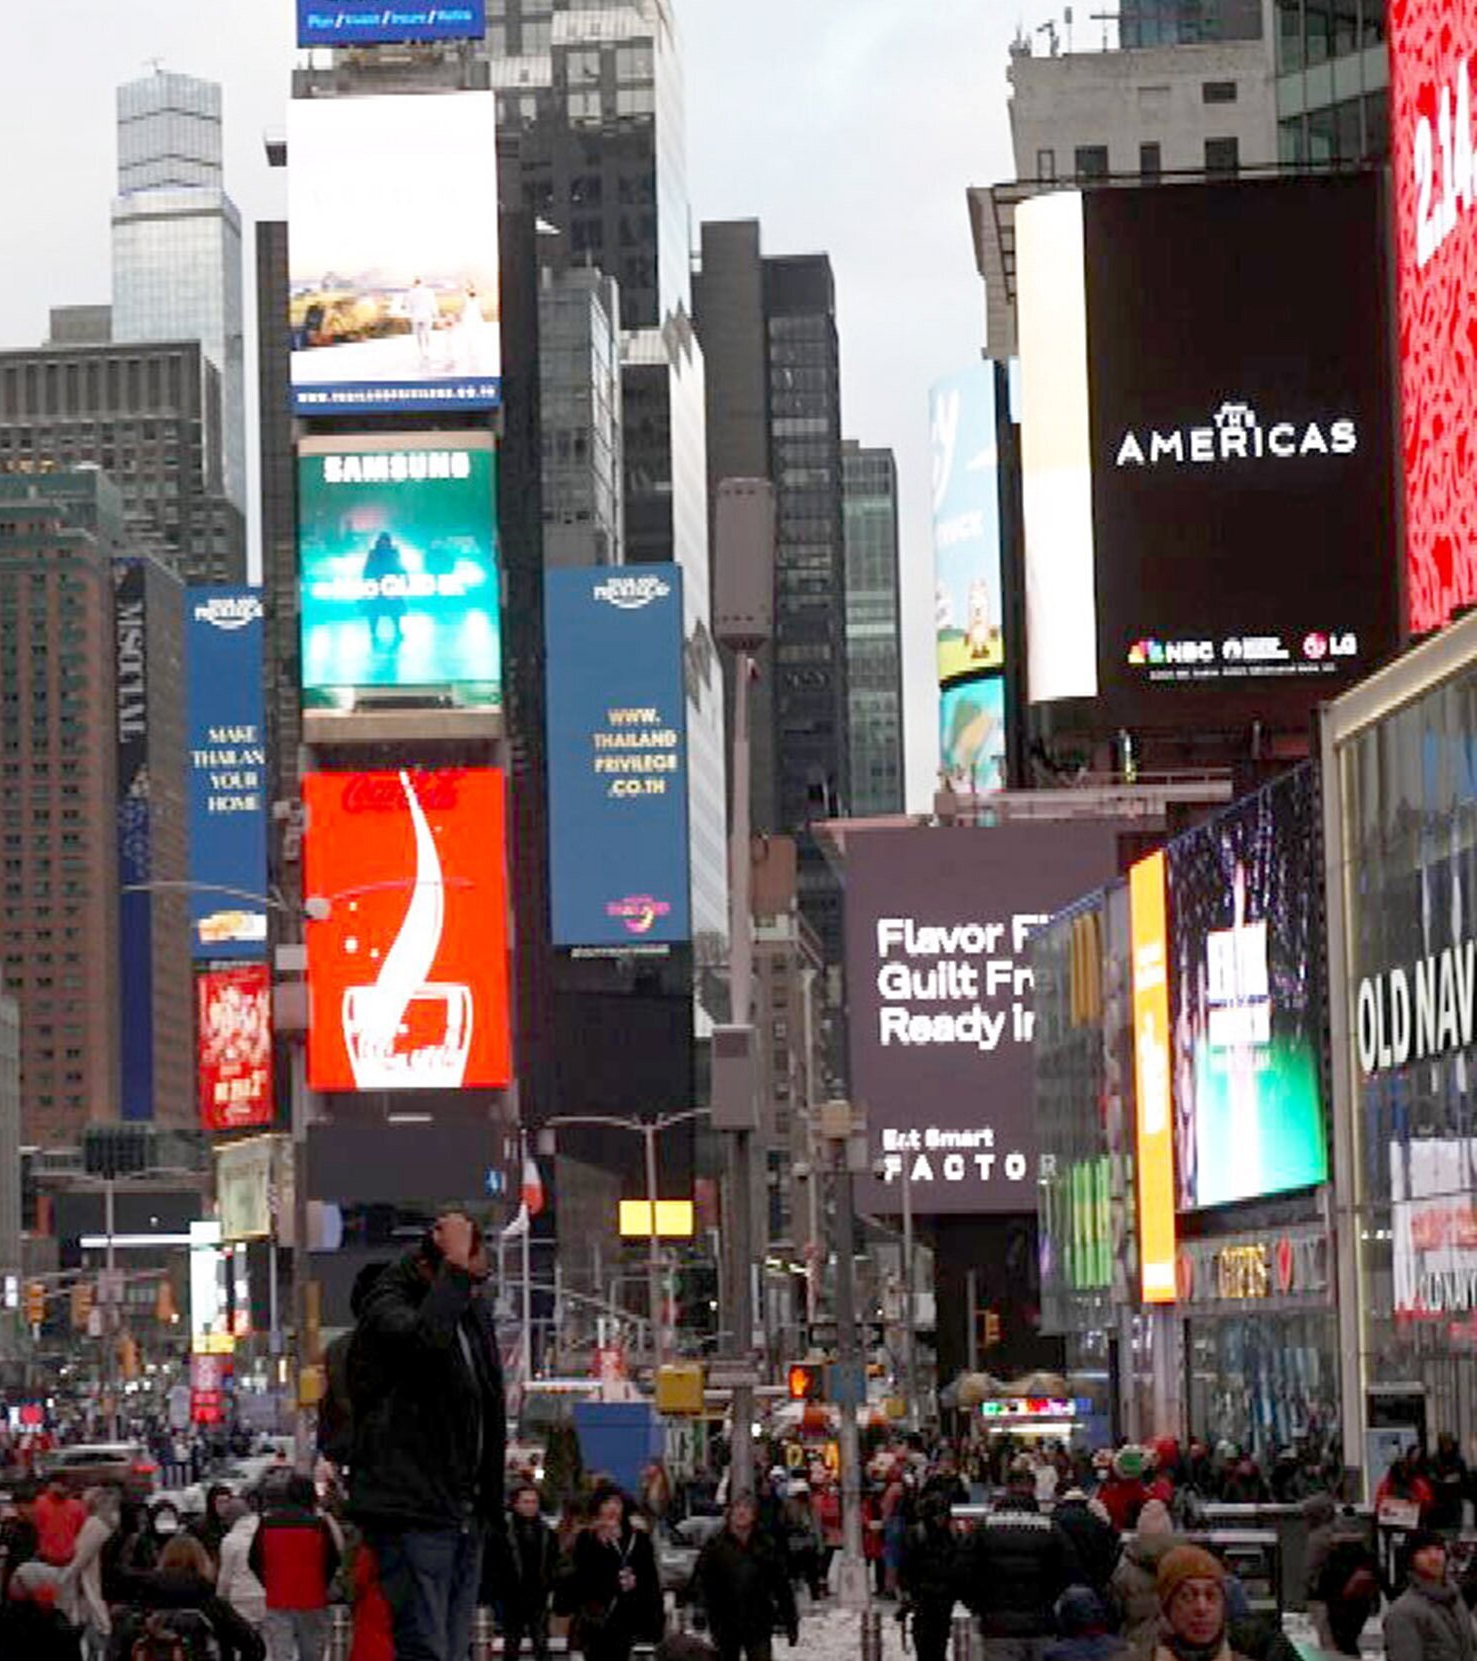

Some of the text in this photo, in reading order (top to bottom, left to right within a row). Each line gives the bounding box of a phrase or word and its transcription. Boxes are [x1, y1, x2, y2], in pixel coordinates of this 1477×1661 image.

[1116, 420, 1358, 466] AMERICAS
[324, 452, 470, 483] SAMSUNG
[1165, 640, 1214, 663] NBC
[608, 708, 661, 725] WWW.
[208, 725, 257, 744] MAKE
[594, 731, 676, 749] THAILAND
[192, 750, 265, 768] THAILAN
[594, 754, 677, 773] PRIVILEGE
[210, 772, 258, 790] YOUR
[208, 796, 260, 812] HOME
[877, 917, 1004, 957] Flavor
[877, 961, 977, 1000] Guilt
[1358, 940, 1475, 1073] OLD NAV
[879, 1003, 1006, 1051] Ready
[883, 1153, 1056, 1184] FACTOR
